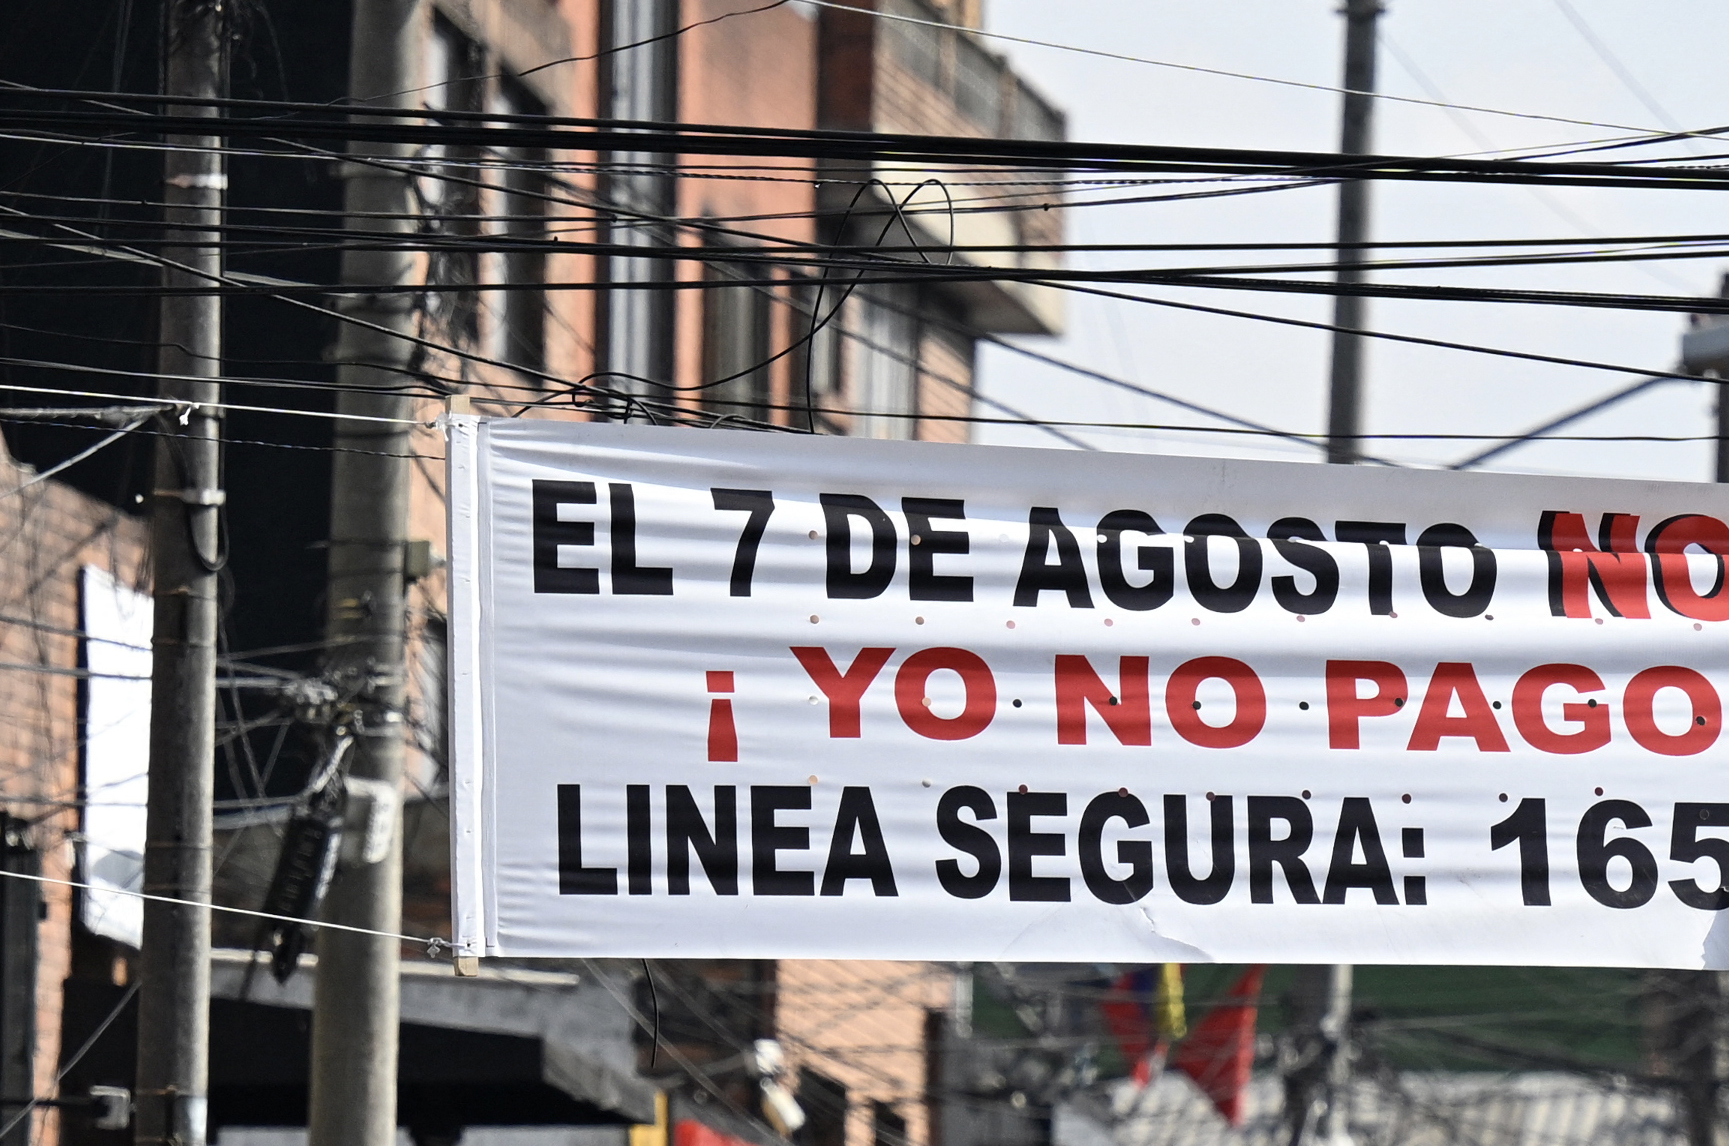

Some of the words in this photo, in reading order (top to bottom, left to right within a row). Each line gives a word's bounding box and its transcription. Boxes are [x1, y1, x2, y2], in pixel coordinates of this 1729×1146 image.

[532, 479, 674, 596] EL
[710, 487, 775, 597] 7
[819, 492, 974, 602] DE
[1013, 506, 1498, 619] AGOSTO
[1054, 654, 1267, 749] NO
[557, 783, 899, 897] LINEA
[935, 784, 1427, 905] SEGURA:
